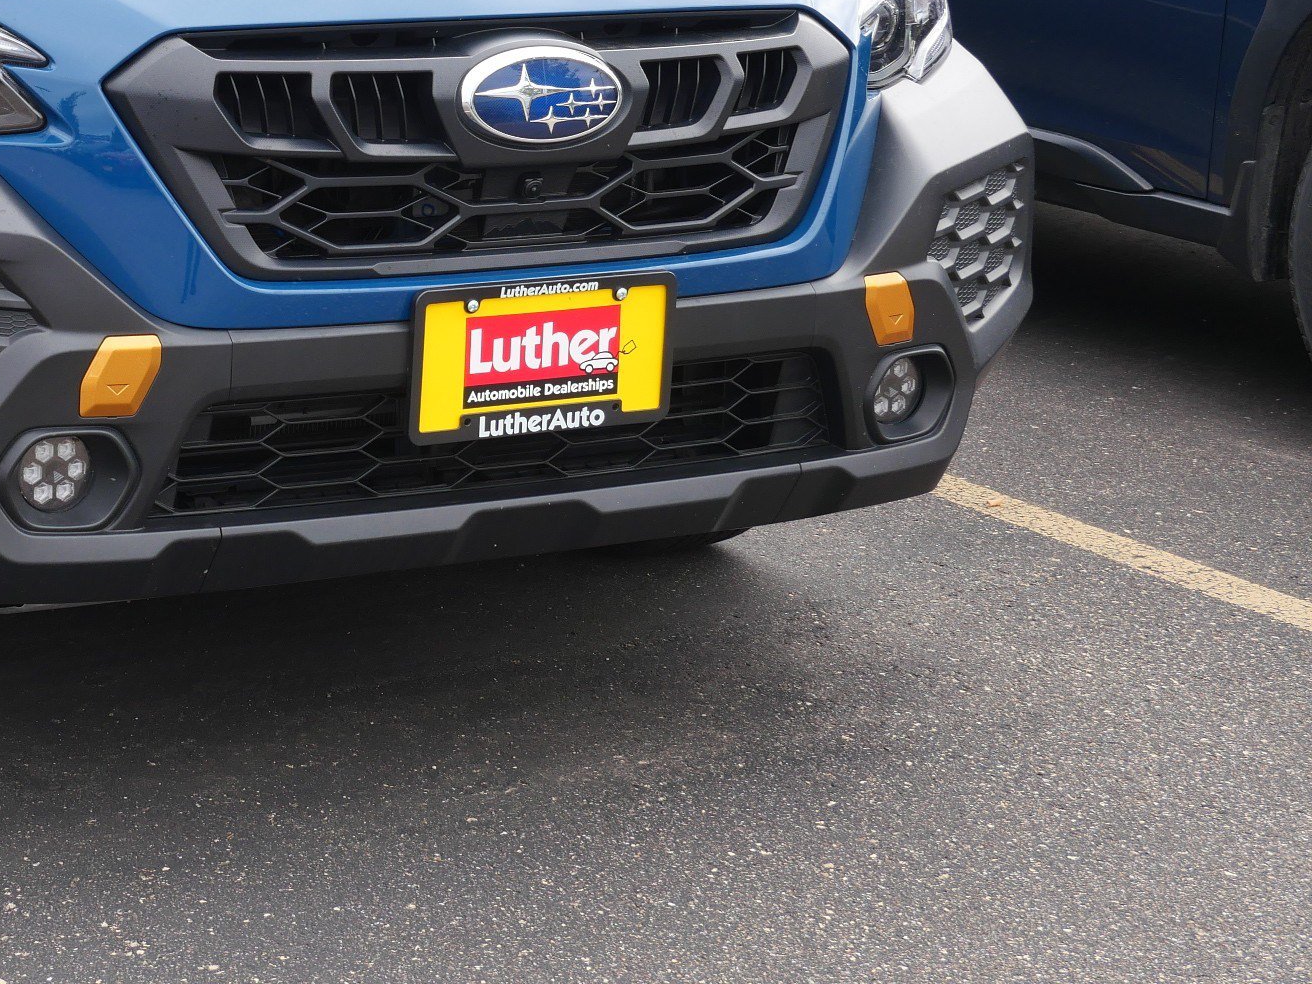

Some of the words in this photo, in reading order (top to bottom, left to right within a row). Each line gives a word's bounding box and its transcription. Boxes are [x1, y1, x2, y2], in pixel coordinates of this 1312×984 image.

[499, 281, 599, 299] LutherAuto.com
[469, 321, 618, 375] Luther
[467, 384, 541, 404] Automobile
[544, 377, 614, 398] Dealerships
[478, 407, 605, 439] LutherAuto
